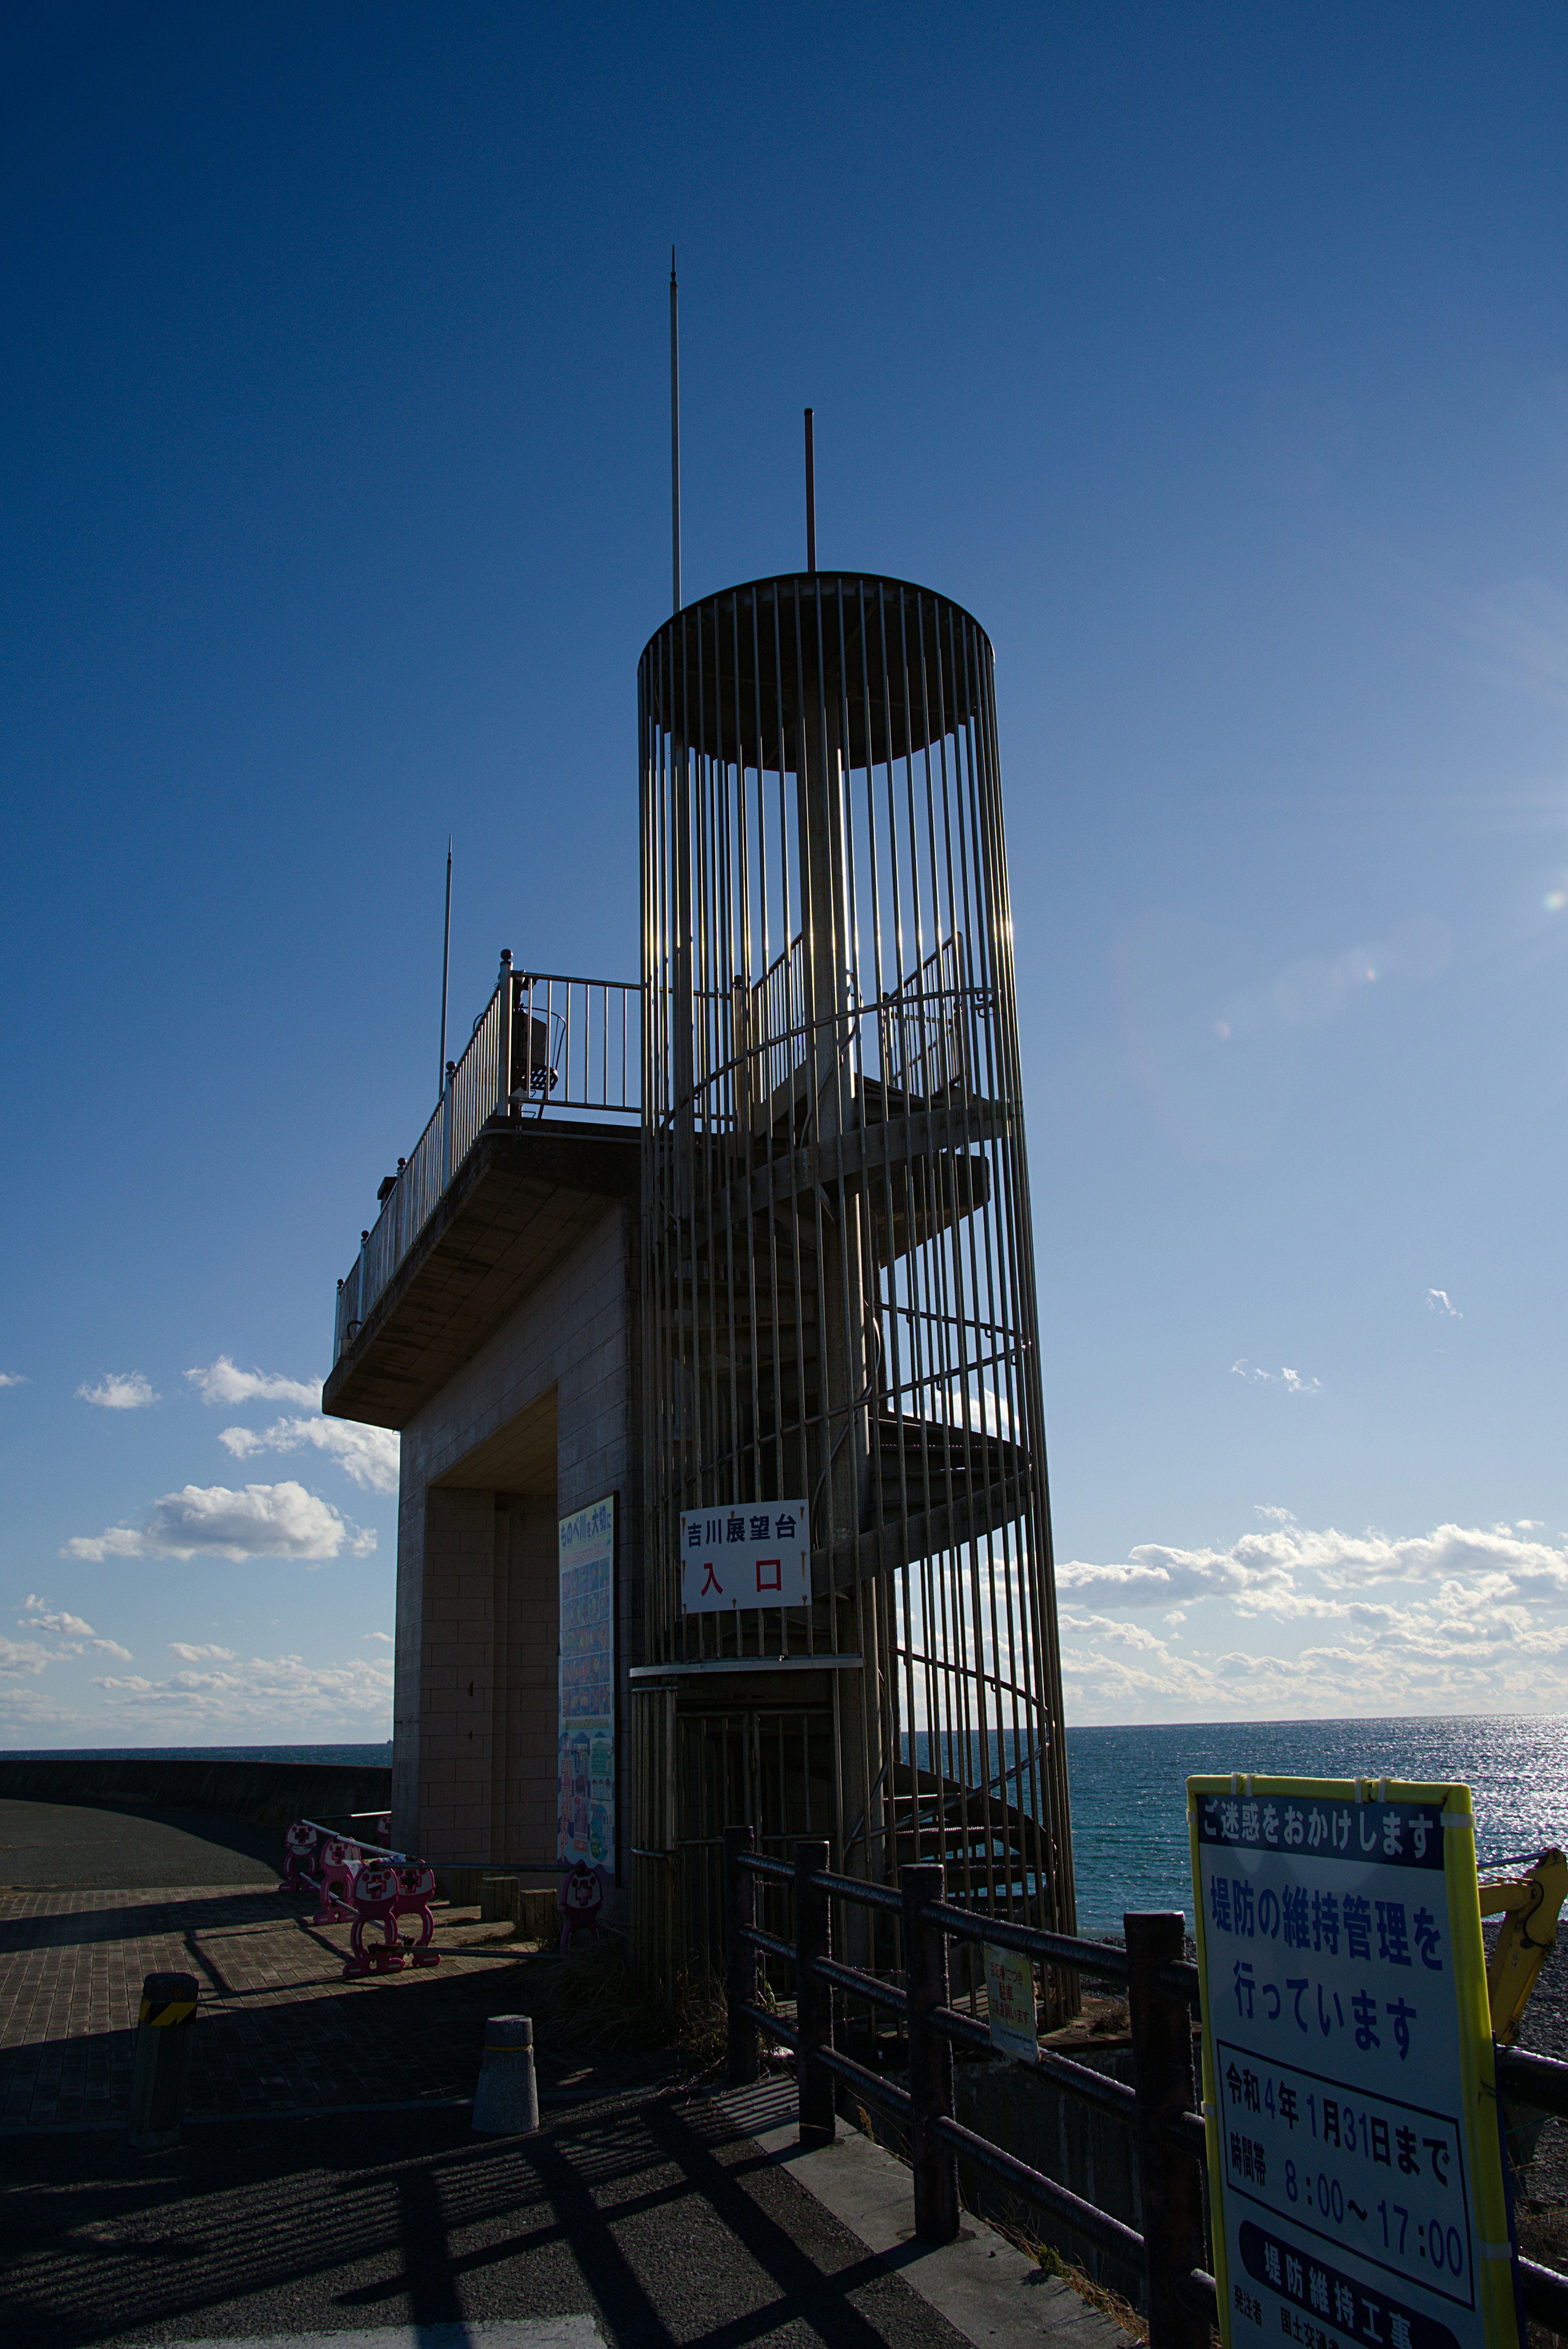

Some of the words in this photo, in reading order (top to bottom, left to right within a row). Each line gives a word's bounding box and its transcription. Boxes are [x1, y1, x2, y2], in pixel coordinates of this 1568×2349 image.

[561, 1505, 611, 1548] ものべ川を大切に
[688, 1513, 796, 1548] 吉川展望台
[1203, 1799, 1434, 1859] ご迷惑をおかけします
[1210, 1874, 1443, 1971] 堤防の維持管理を
[998, 1982, 1014, 2003] 駐車
[1233, 1959, 1417, 2060] 行っています
[1230, 2131, 1266, 2187] 時間帯
[1234, 2284, 1263, 2328] 発注者
[1264, 2240, 1413, 2349] 堤防維持工事
